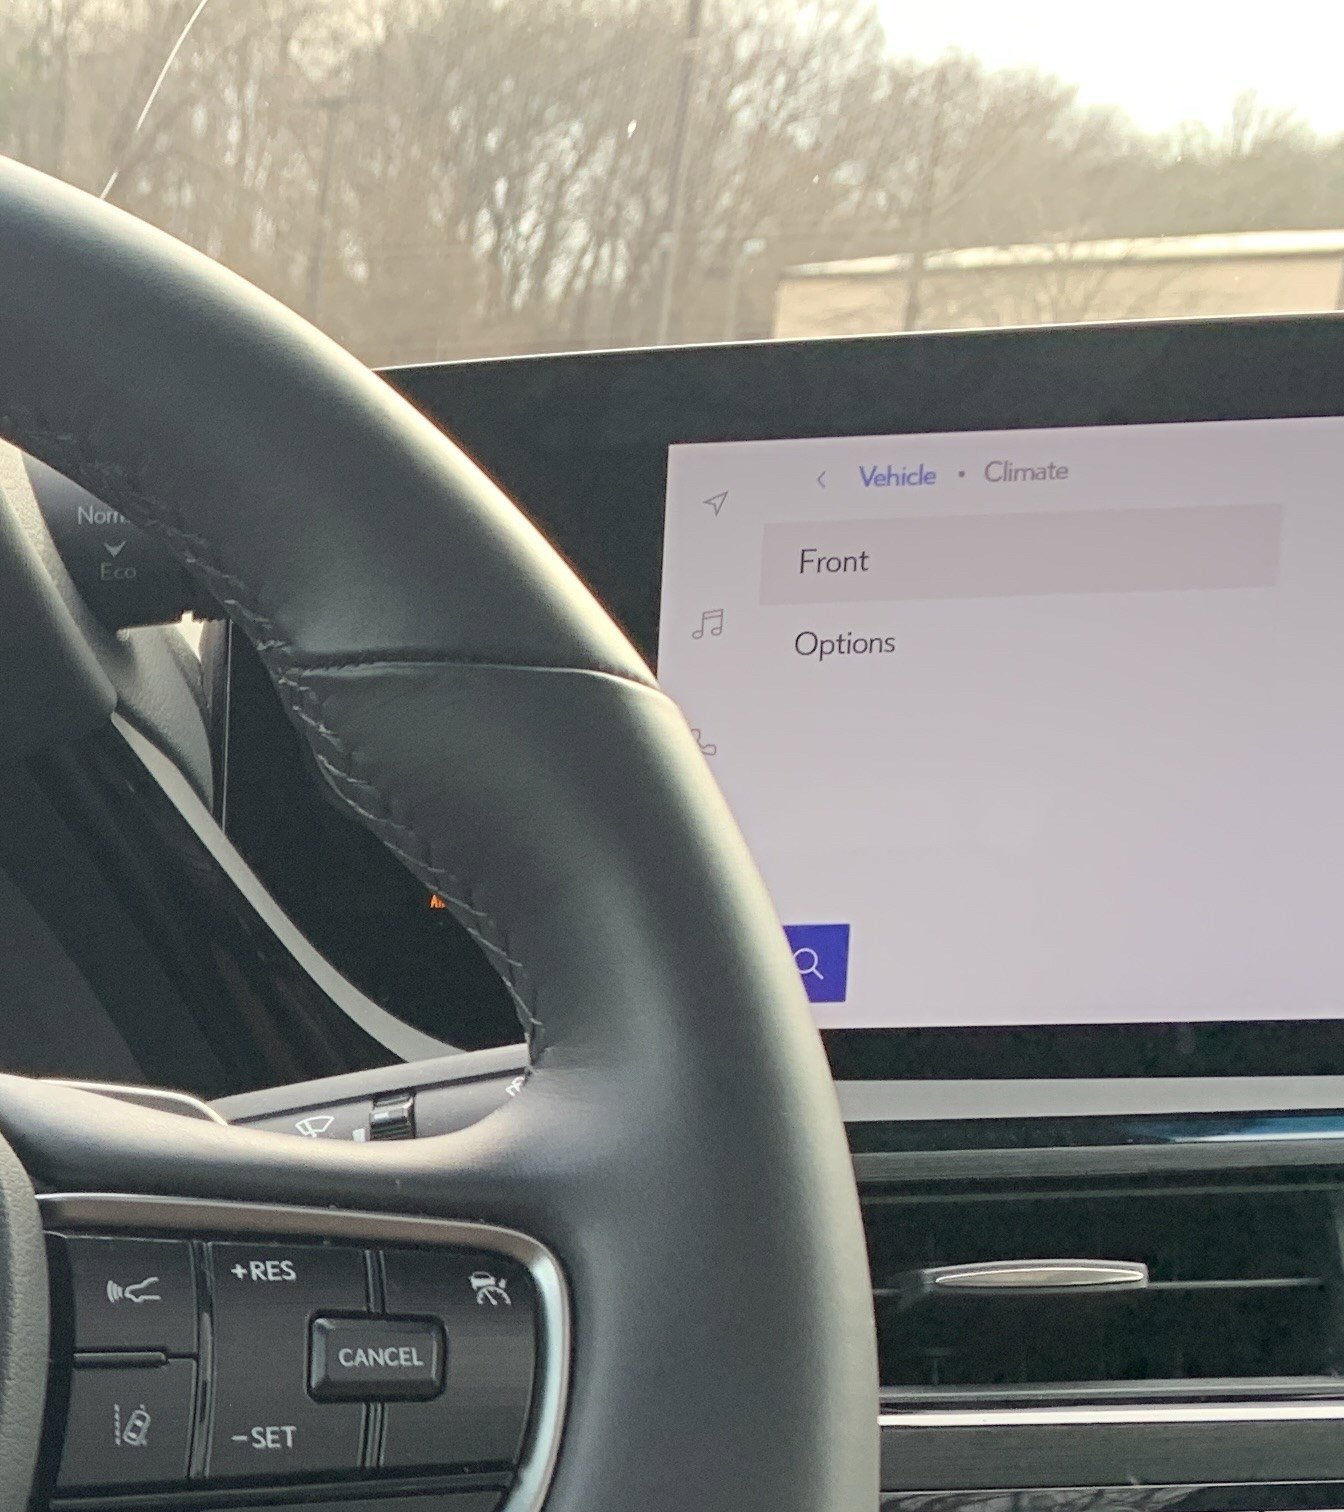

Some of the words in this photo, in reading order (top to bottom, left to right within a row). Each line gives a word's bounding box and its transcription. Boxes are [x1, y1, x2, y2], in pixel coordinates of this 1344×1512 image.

[858, 465, 937, 489] Vehicle
[983, 460, 1069, 485] Climate
[99, 562, 137, 581] Eco
[798, 548, 870, 574] Front
[793, 631, 896, 661] Options
[231, 1260, 297, 1283] +RES
[338, 1345, 424, 1368] CANCEL
